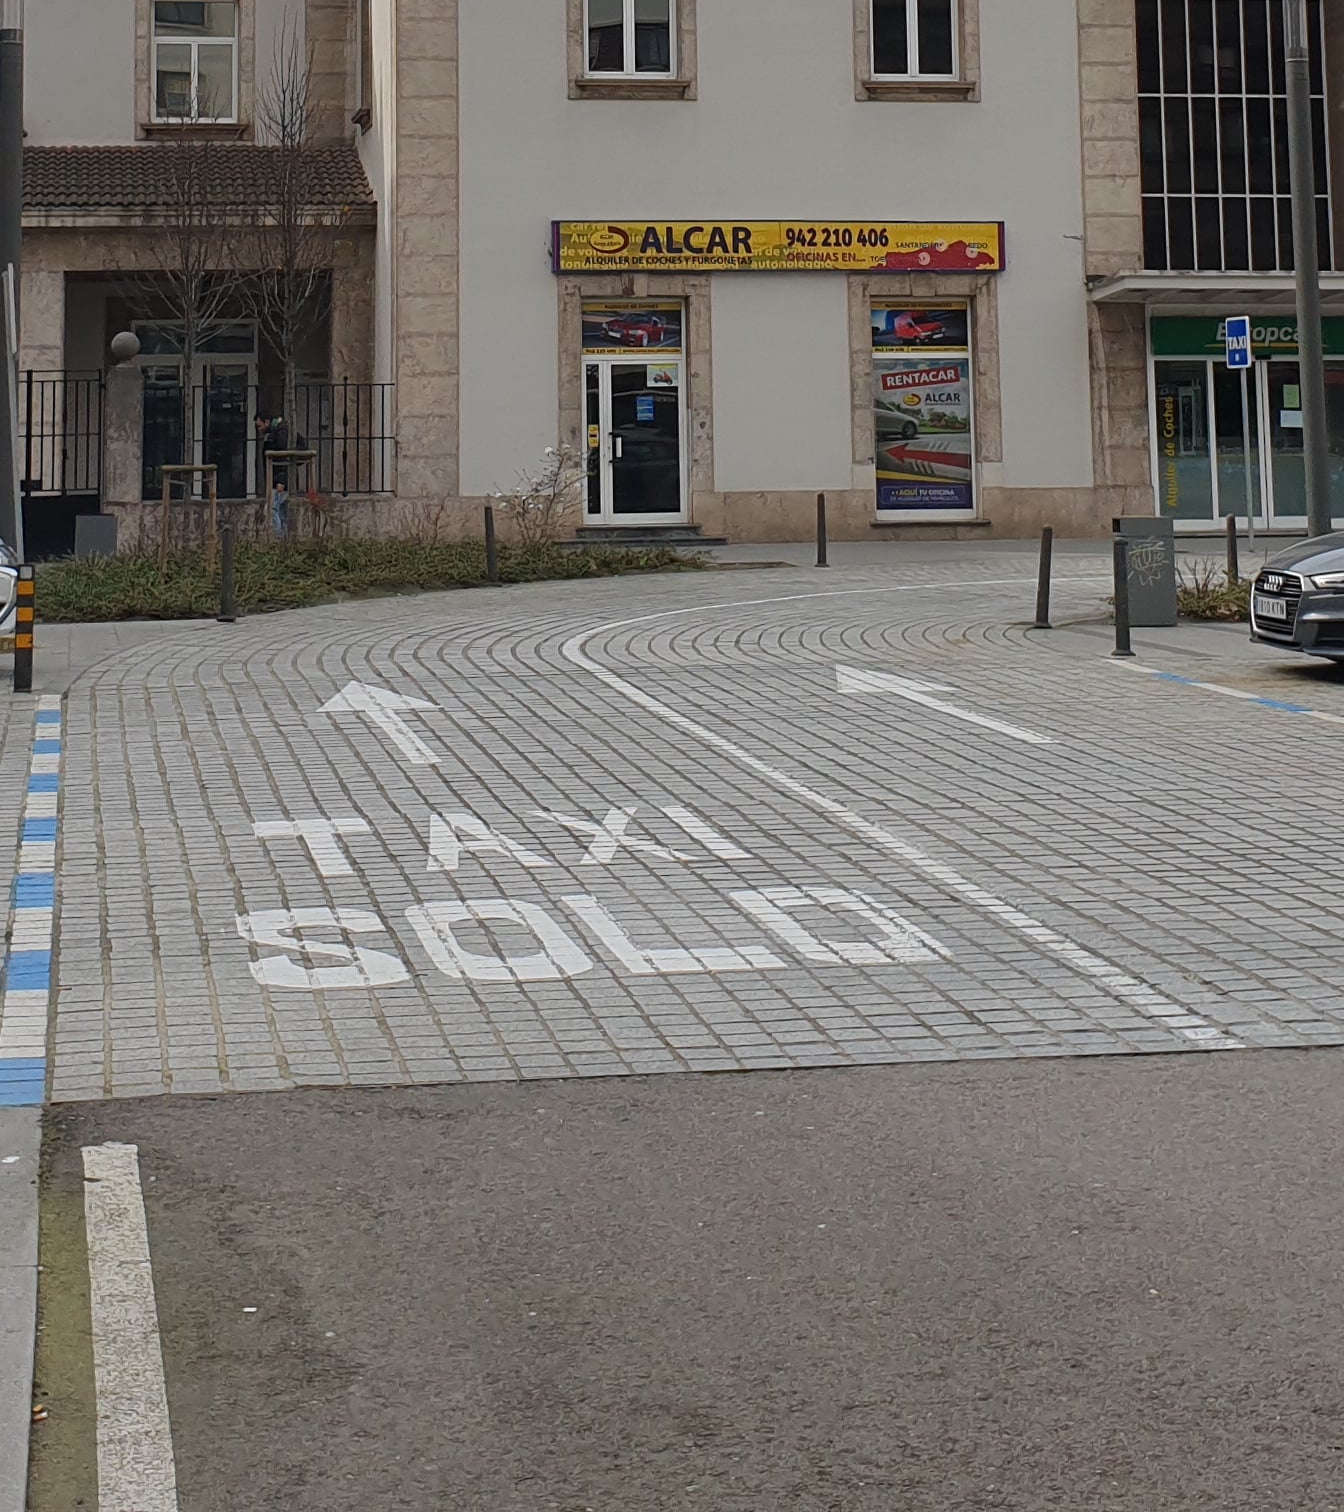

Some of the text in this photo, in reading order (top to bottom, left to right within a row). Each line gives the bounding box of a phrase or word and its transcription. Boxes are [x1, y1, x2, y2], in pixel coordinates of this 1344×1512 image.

[639, 226, 753, 254] ALCAR
[785, 227, 889, 248] 942 210 406
[584, 255, 630, 266] ALQUILER
[632, 256, 644, 265] DE
[646, 256, 683, 265] COCHES
[684, 256, 691, 265] Y
[692, 256, 753, 266] FURGONETAS
[787, 252, 839, 262] OFICINAS
[1228, 336, 1247, 350] TAXI
[886, 370, 956, 387] RENTACAR
[925, 392, 961, 402] ALCAR
[1163, 396, 1178, 507] Alquiler de Coches
[251, 806, 754, 877] TAXI
[235, 887, 957, 990] SOLO
